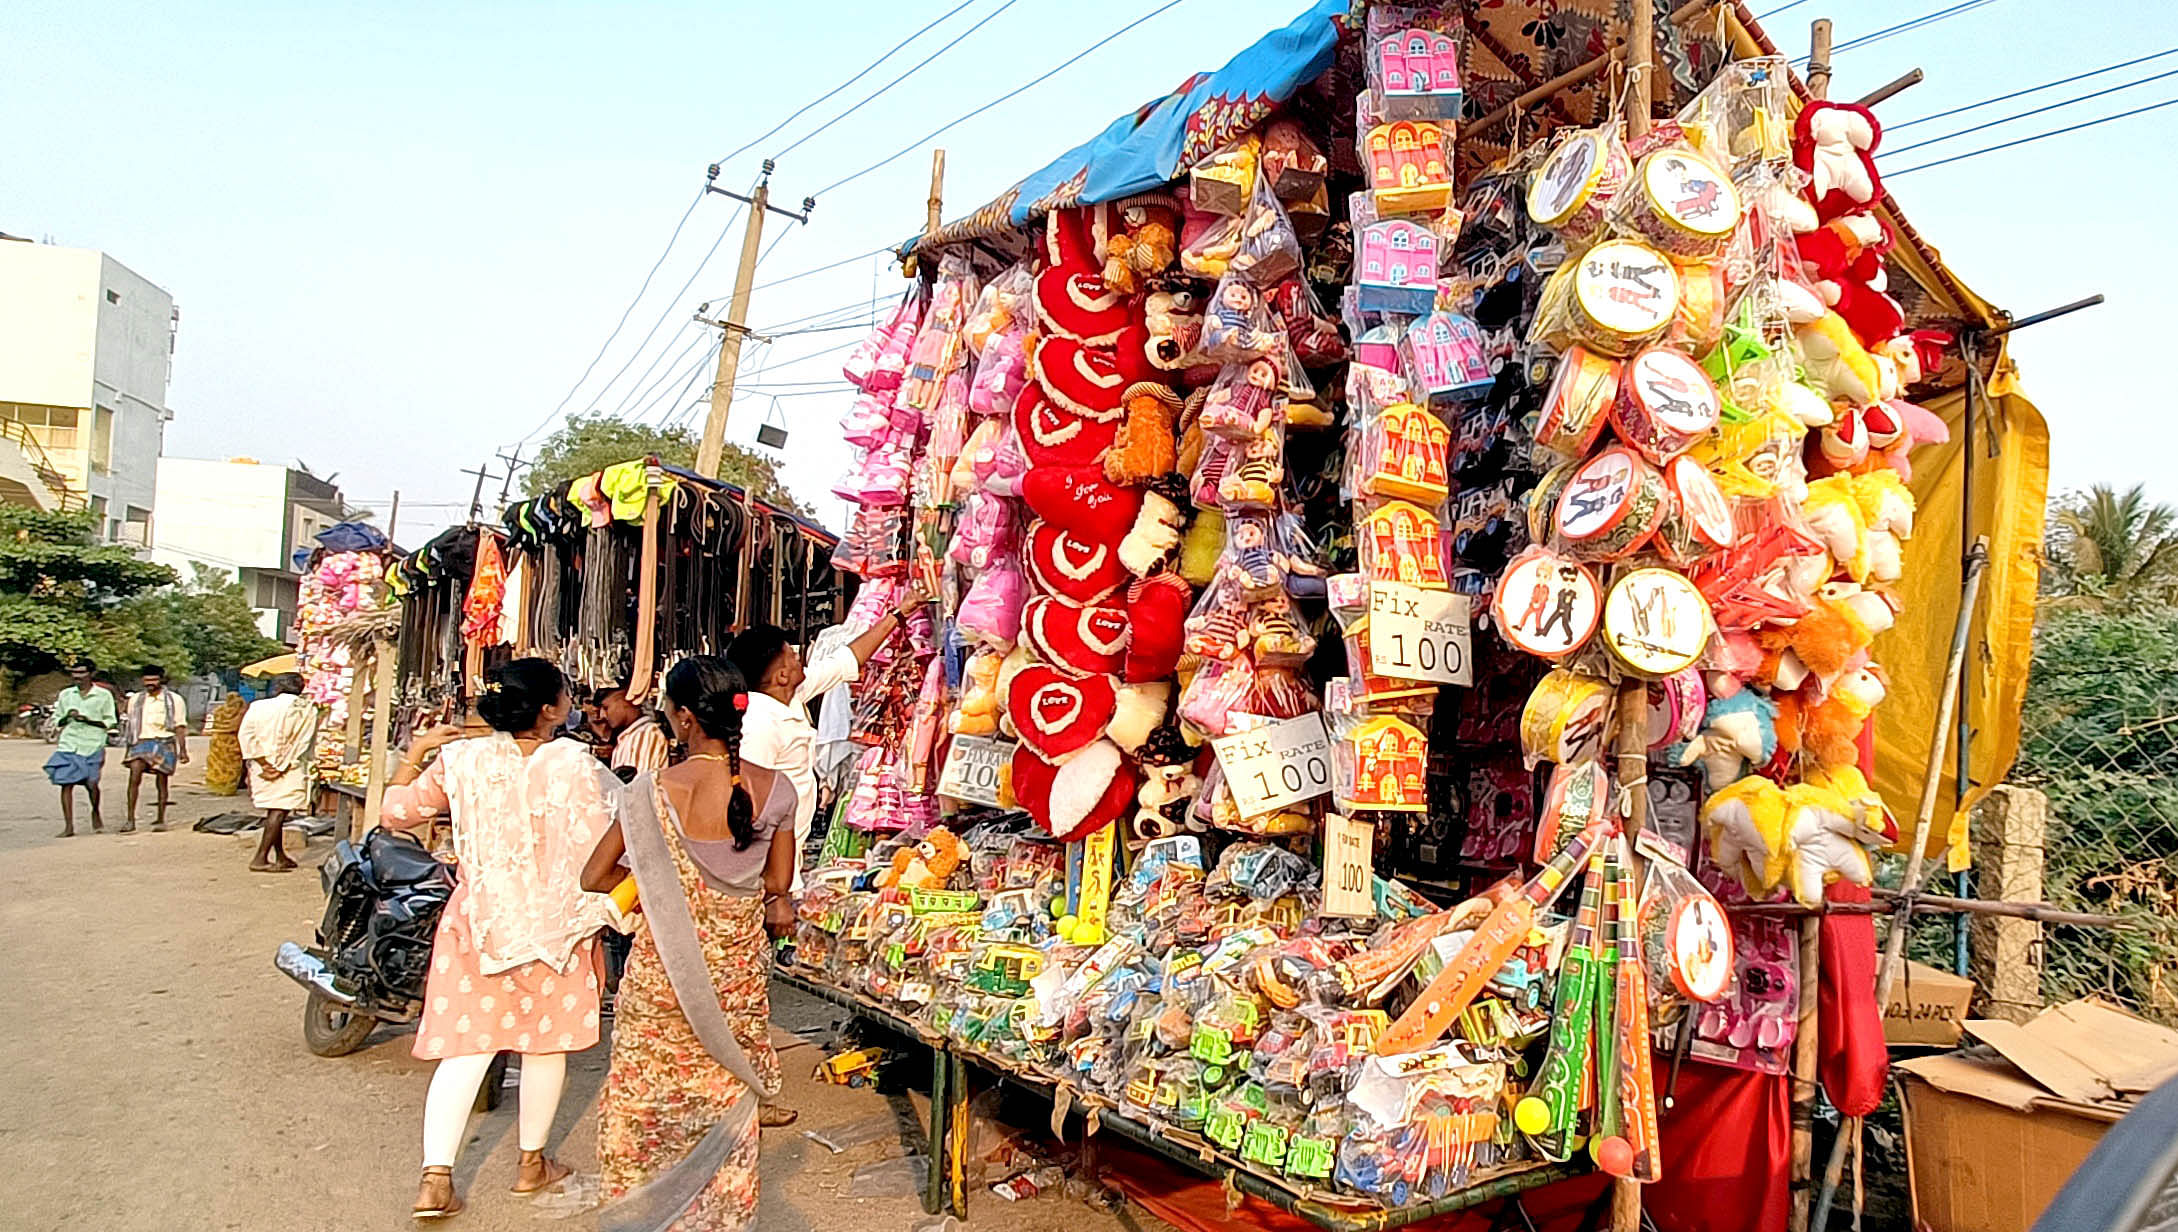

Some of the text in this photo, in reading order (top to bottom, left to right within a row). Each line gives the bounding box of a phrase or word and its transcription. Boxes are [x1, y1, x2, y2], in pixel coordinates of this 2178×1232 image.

[1424, 620, 1467, 636] RATE
[1392, 634, 1462, 673] 100
[1280, 740, 1326, 760] RATE
[1253, 756, 1327, 800] 100
[1341, 861, 1363, 893] 100
